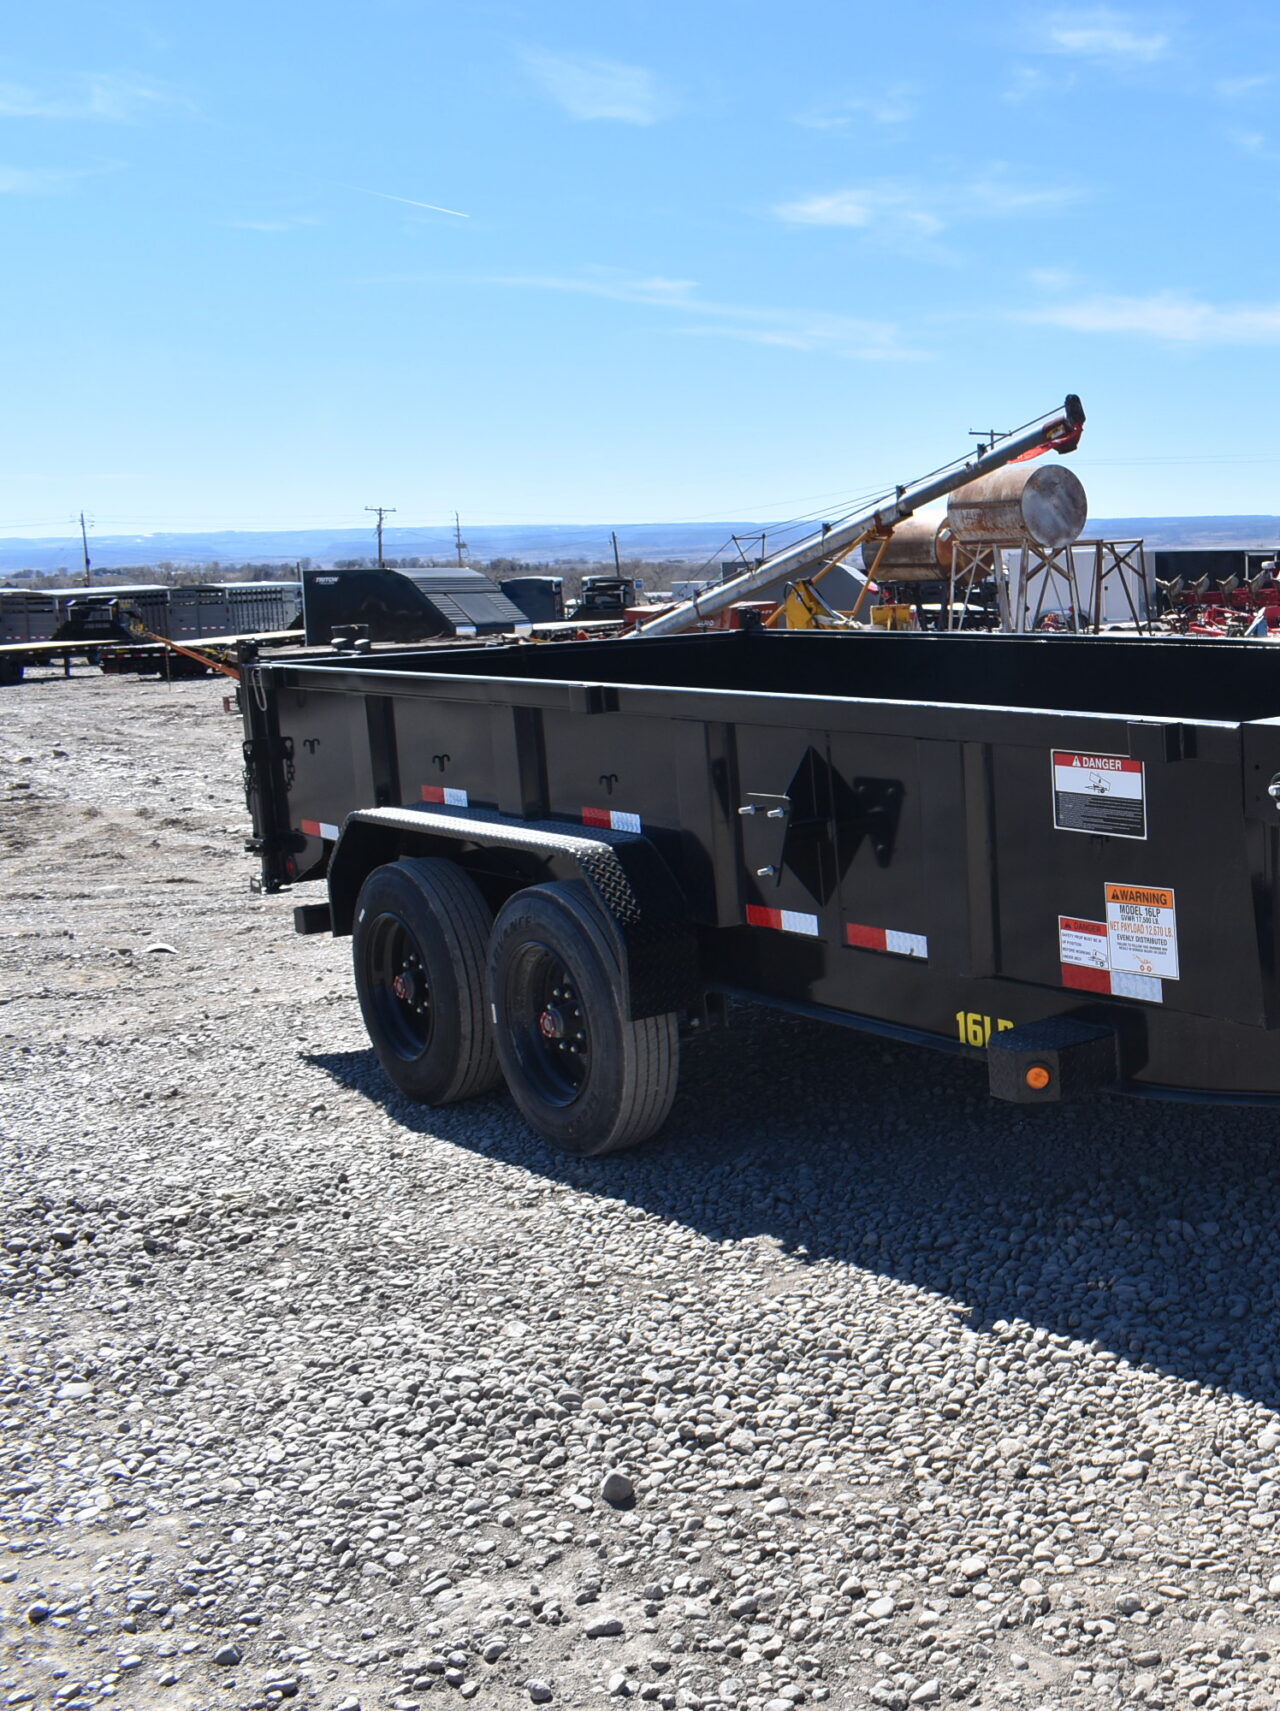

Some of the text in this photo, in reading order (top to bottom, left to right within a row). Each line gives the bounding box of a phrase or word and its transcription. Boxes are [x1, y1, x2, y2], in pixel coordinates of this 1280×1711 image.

[1082, 757, 1122, 771] DANGER
[1120, 889, 1167, 905] WARNING
[1119, 905, 1160, 917] MODEL 16LP
[1110, 921, 1119, 931] NET
[1121, 922, 1144, 934] PAYLOAD
[1117, 934, 1167, 946] EVENLY DISTRIBUTED
